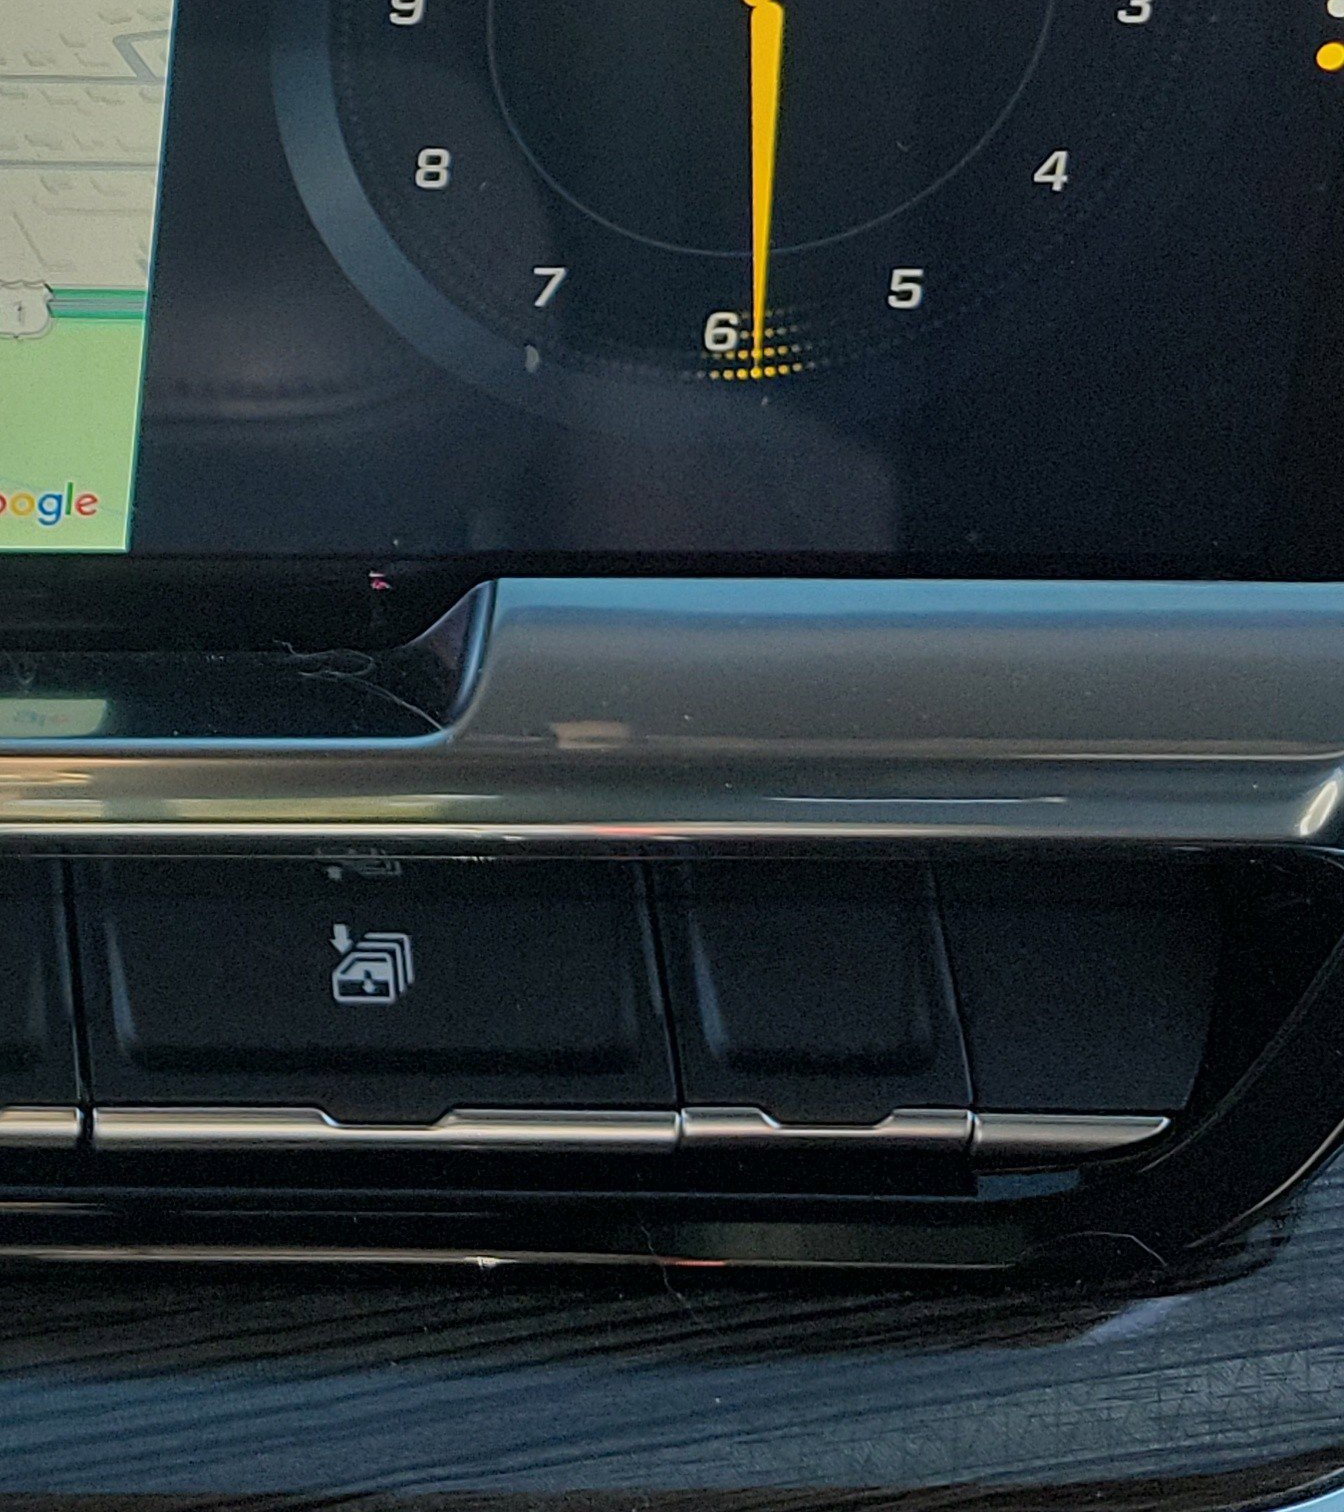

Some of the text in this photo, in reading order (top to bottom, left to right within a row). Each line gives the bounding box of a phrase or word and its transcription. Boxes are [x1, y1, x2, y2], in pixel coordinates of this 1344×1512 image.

[414, 148, 452, 190] 8
[1033, 151, 1069, 192] 4
[532, 267, 567, 308] 7
[887, 269, 925, 310] 5
[703, 312, 739, 351] 6
